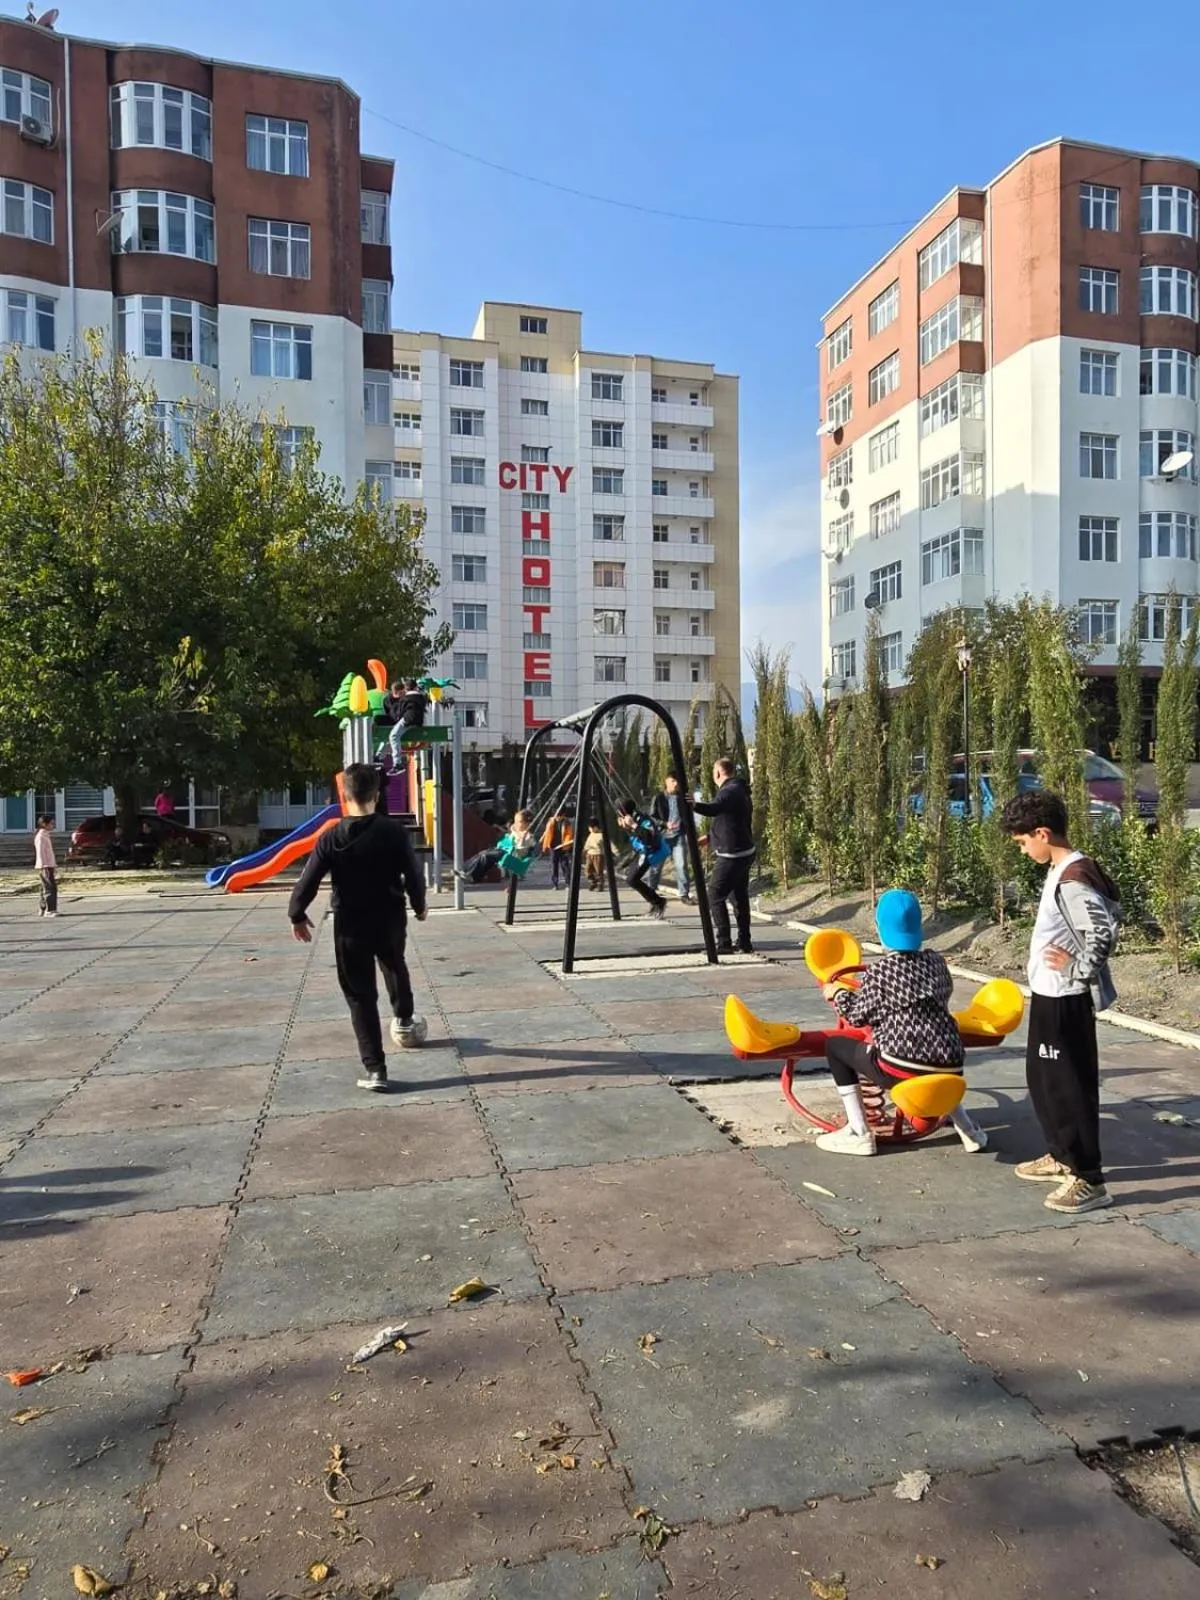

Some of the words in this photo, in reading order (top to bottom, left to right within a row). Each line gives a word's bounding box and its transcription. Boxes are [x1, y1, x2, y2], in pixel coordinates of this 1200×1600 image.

[499, 462, 573, 493] CITY
[522, 511, 552, 728] HOTEL
[1038, 1042, 1060, 1060] Air
